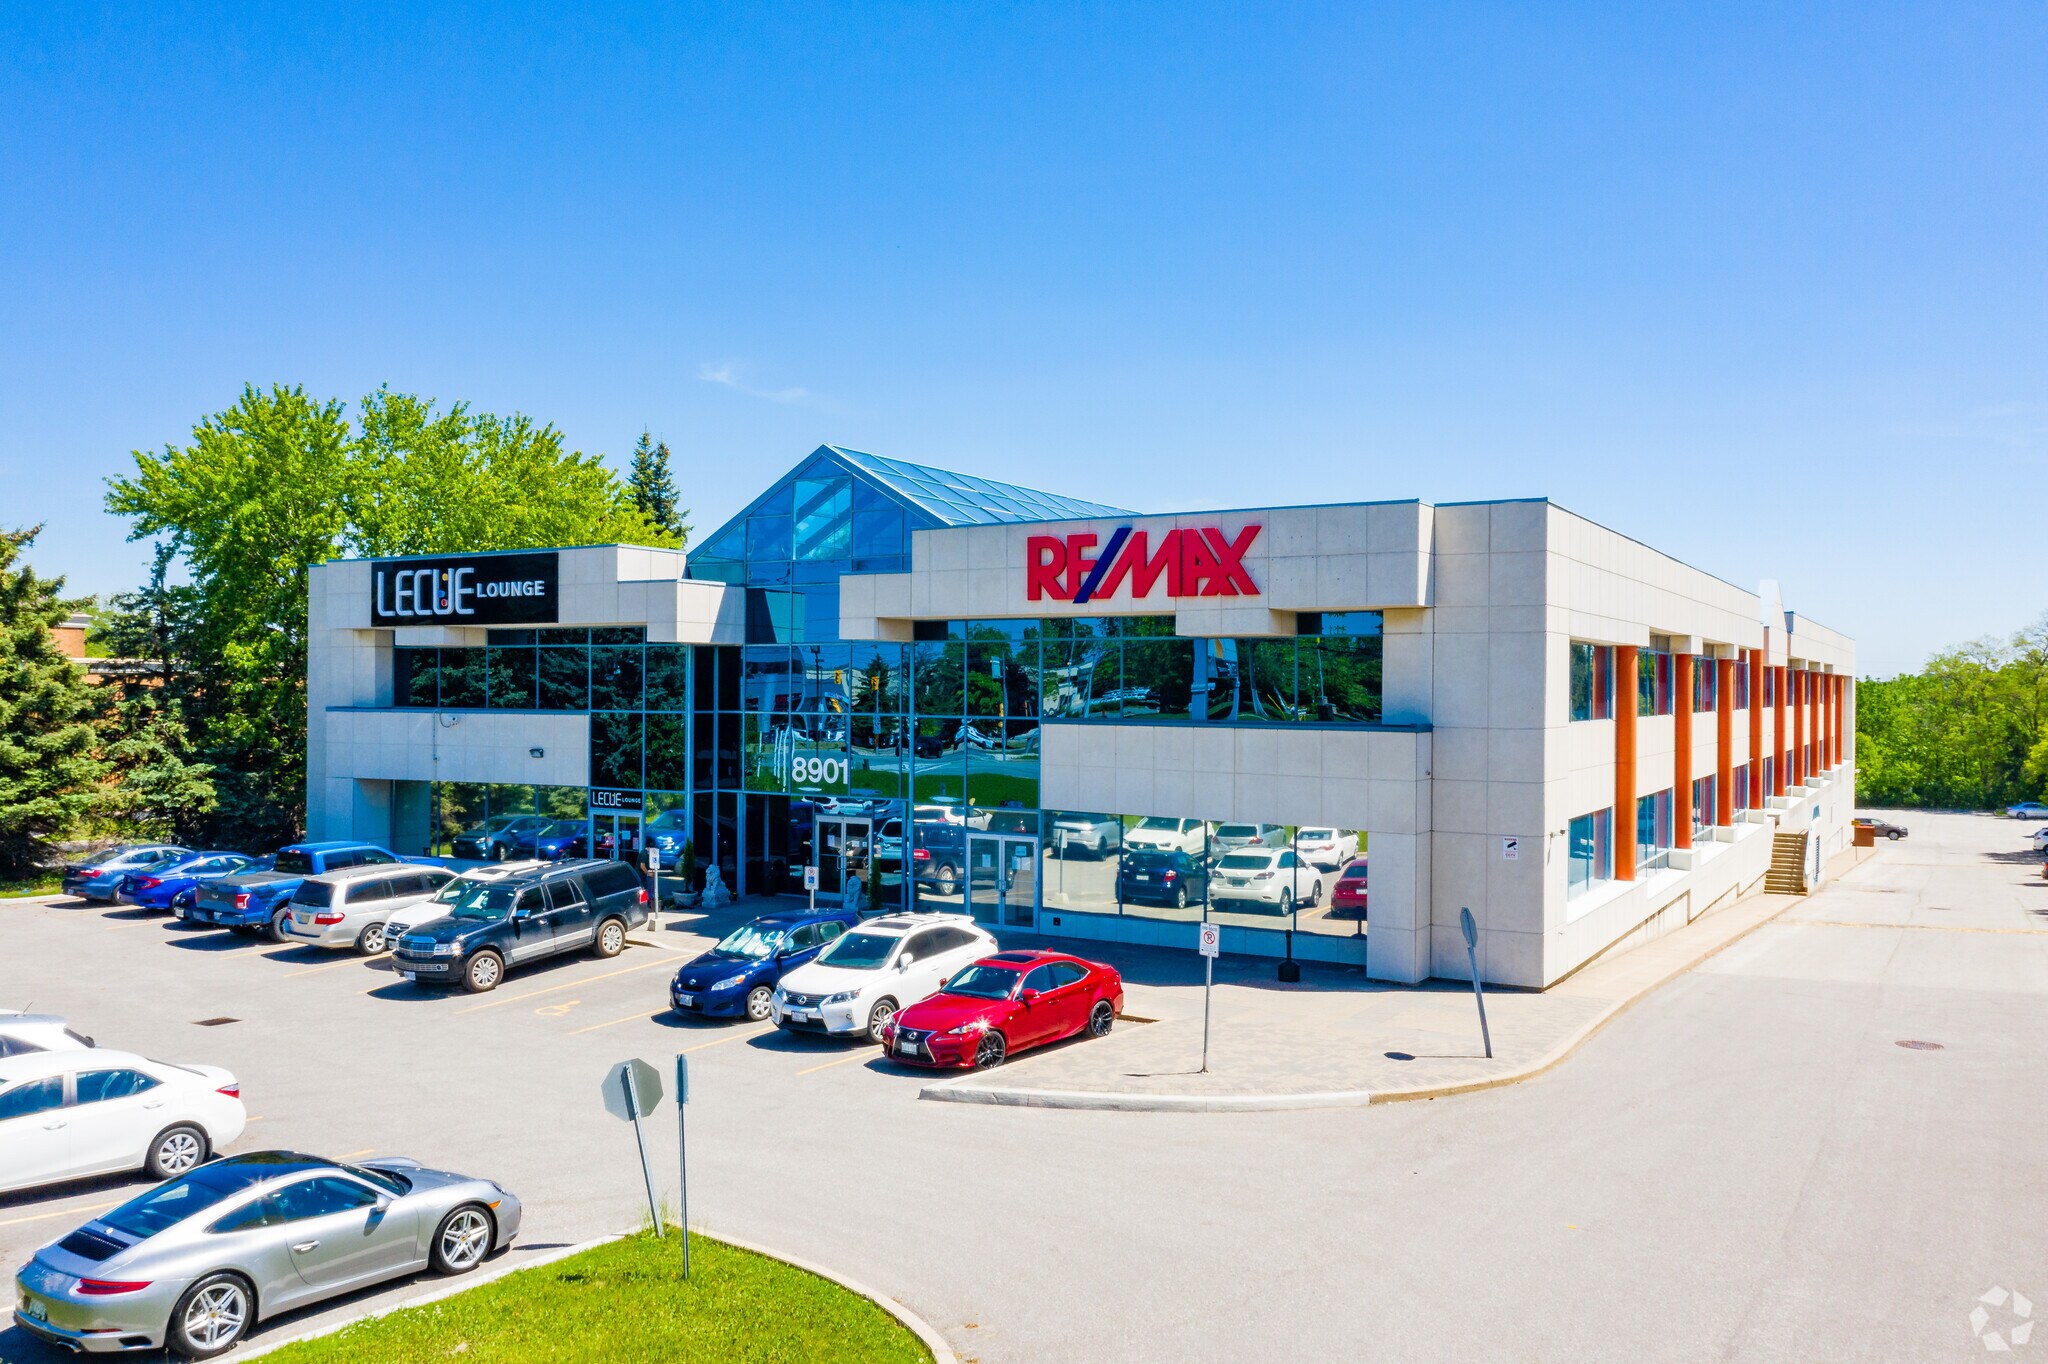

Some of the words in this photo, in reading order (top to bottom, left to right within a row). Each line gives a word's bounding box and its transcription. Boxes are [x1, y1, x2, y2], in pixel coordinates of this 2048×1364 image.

[1027, 525, 1262, 603] RE/MAX
[377, 568, 475, 616] LECUE
[476, 581, 545, 598] LOUNGE
[792, 757, 848, 784] 8901
[592, 791, 621, 806] LECUE
